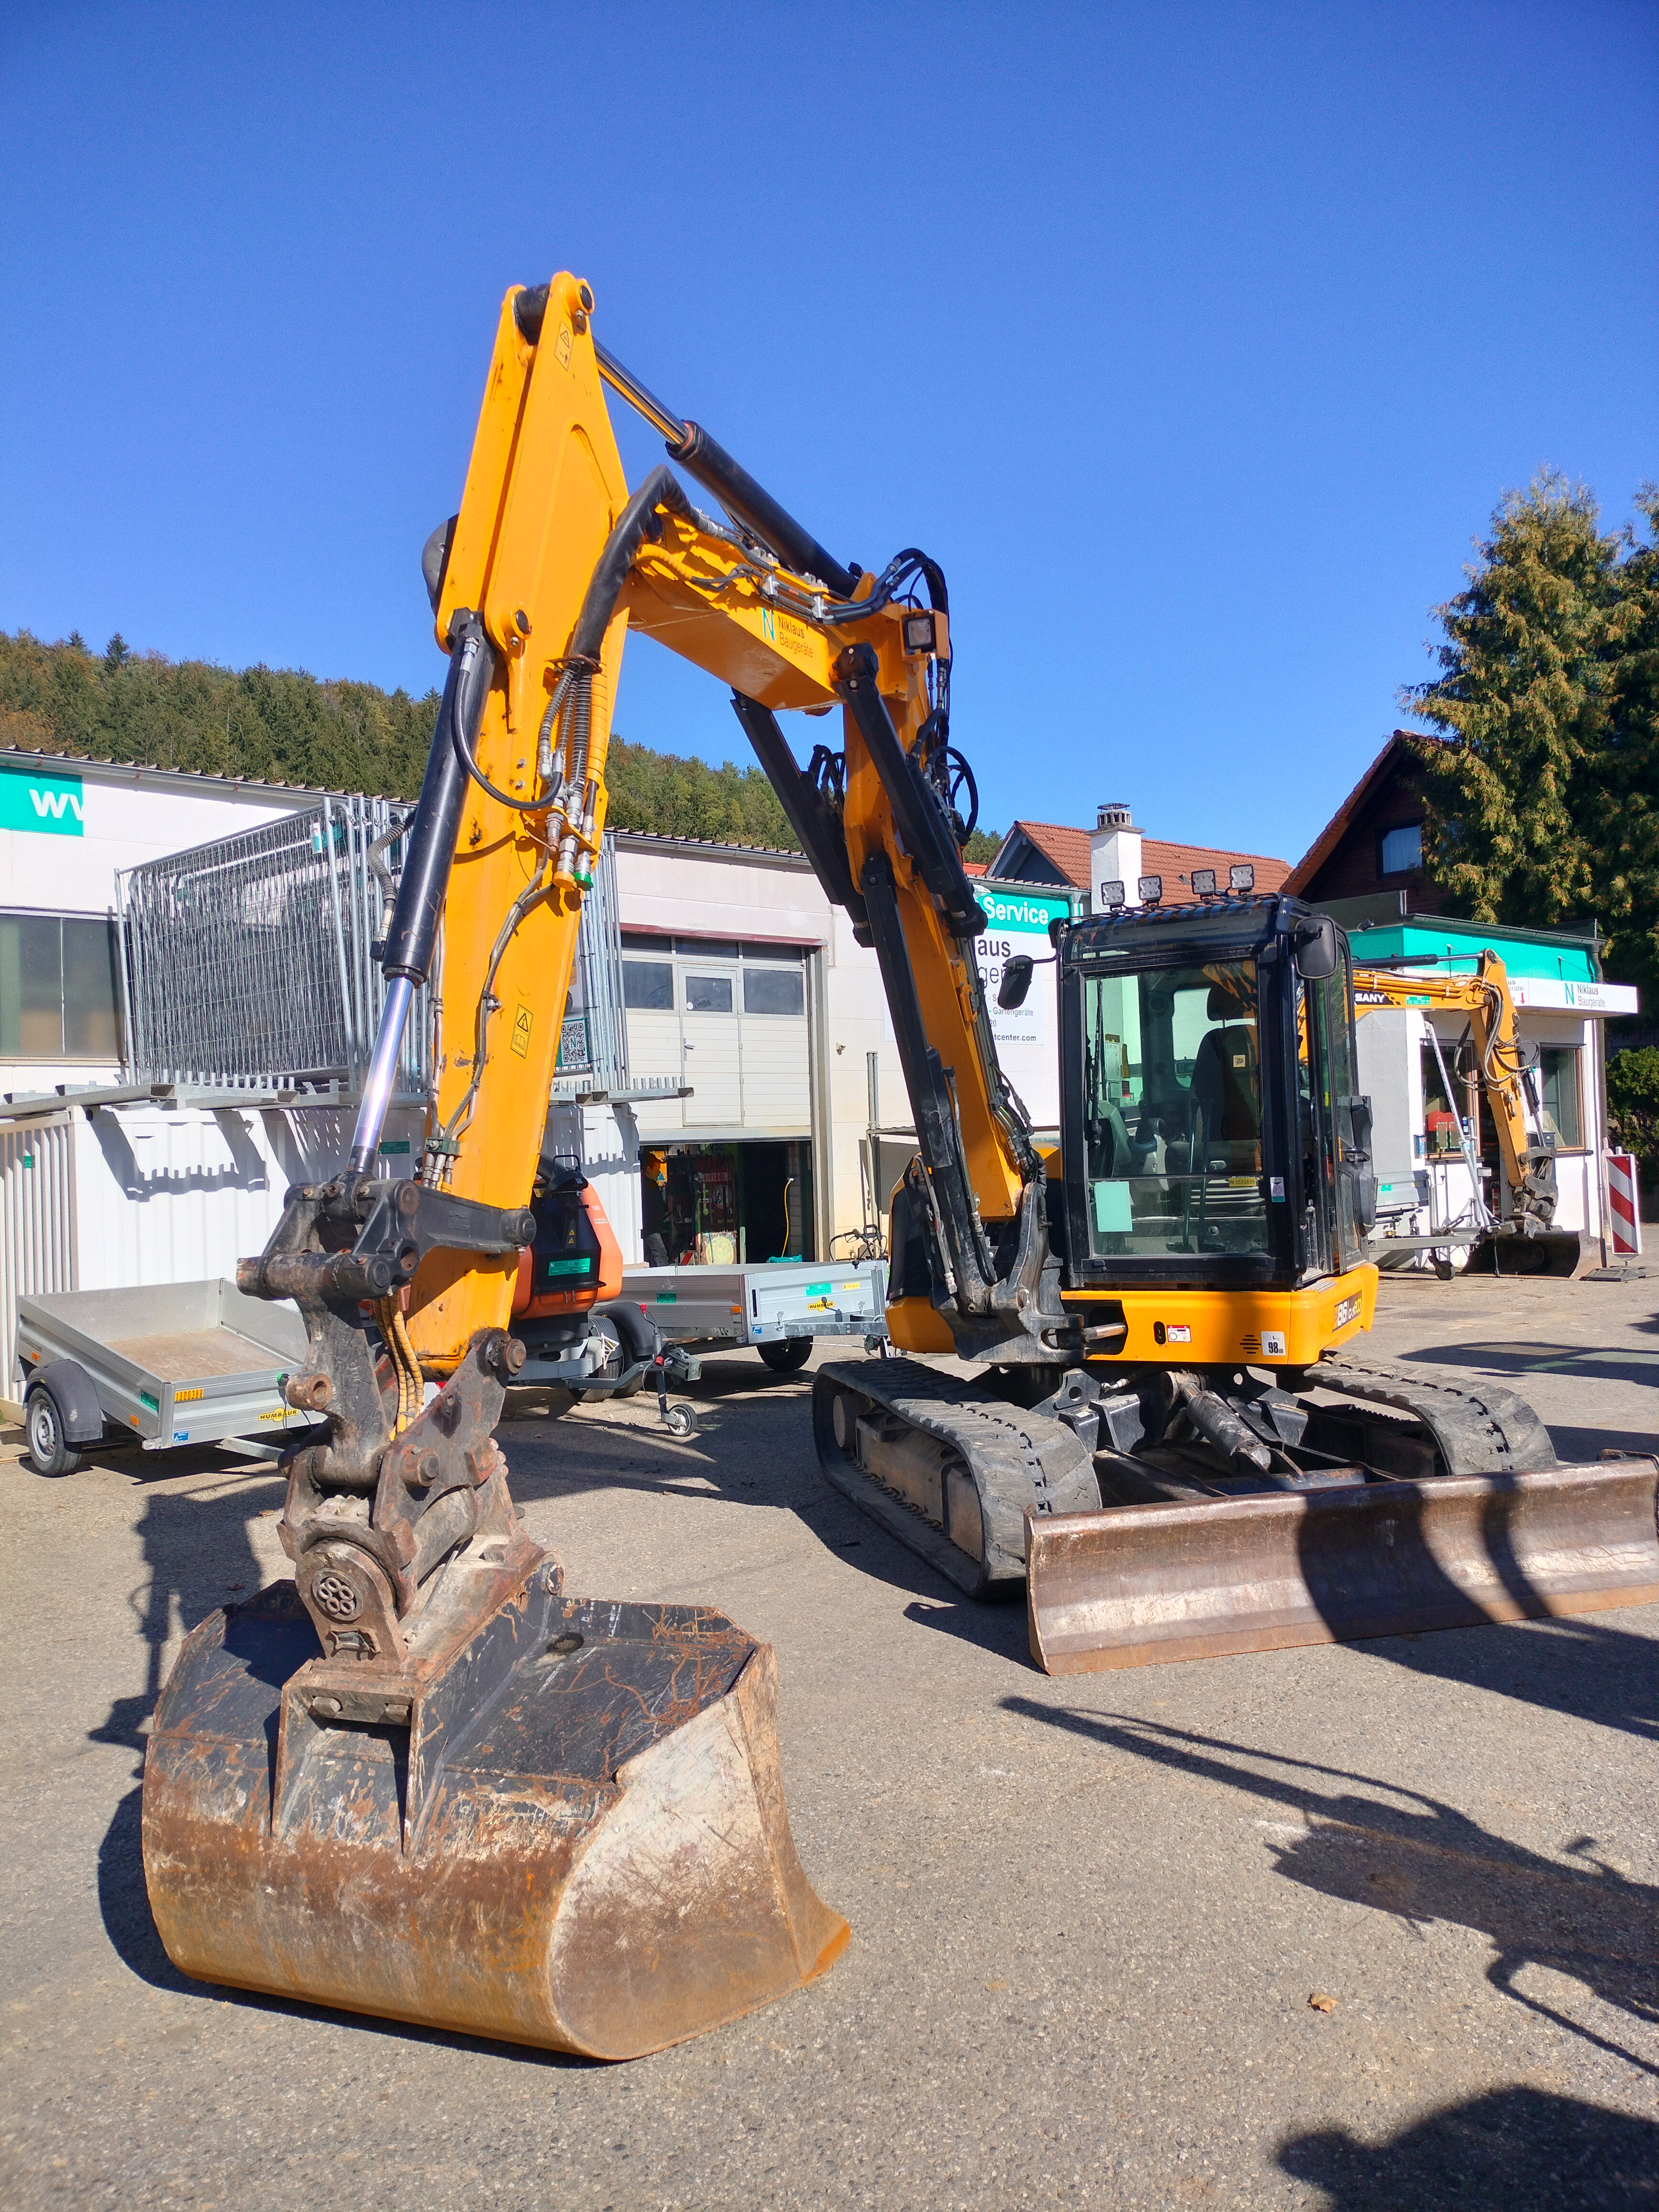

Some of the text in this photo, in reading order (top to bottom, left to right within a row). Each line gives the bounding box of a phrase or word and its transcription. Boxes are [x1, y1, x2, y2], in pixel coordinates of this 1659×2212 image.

[778, 615, 805, 639] Niklaus
[780, 631, 813, 658] Baugeräte
[983, 896, 1049, 925] Service
[978, 939, 1011, 957] aus
[1565, 983, 1574, 1005] N
[1577, 984, 1599, 995] Niklaus
[1355, 993, 1385, 1003] SANY
[1578, 996, 1605, 1008] Baugeräte
[1337, 1301, 1348, 1327] 86
[1268, 1342, 1278, 1353] 98
[176, 1389, 202, 1401] 1800388
[260, 1410, 297, 1420] HUMBAUR
